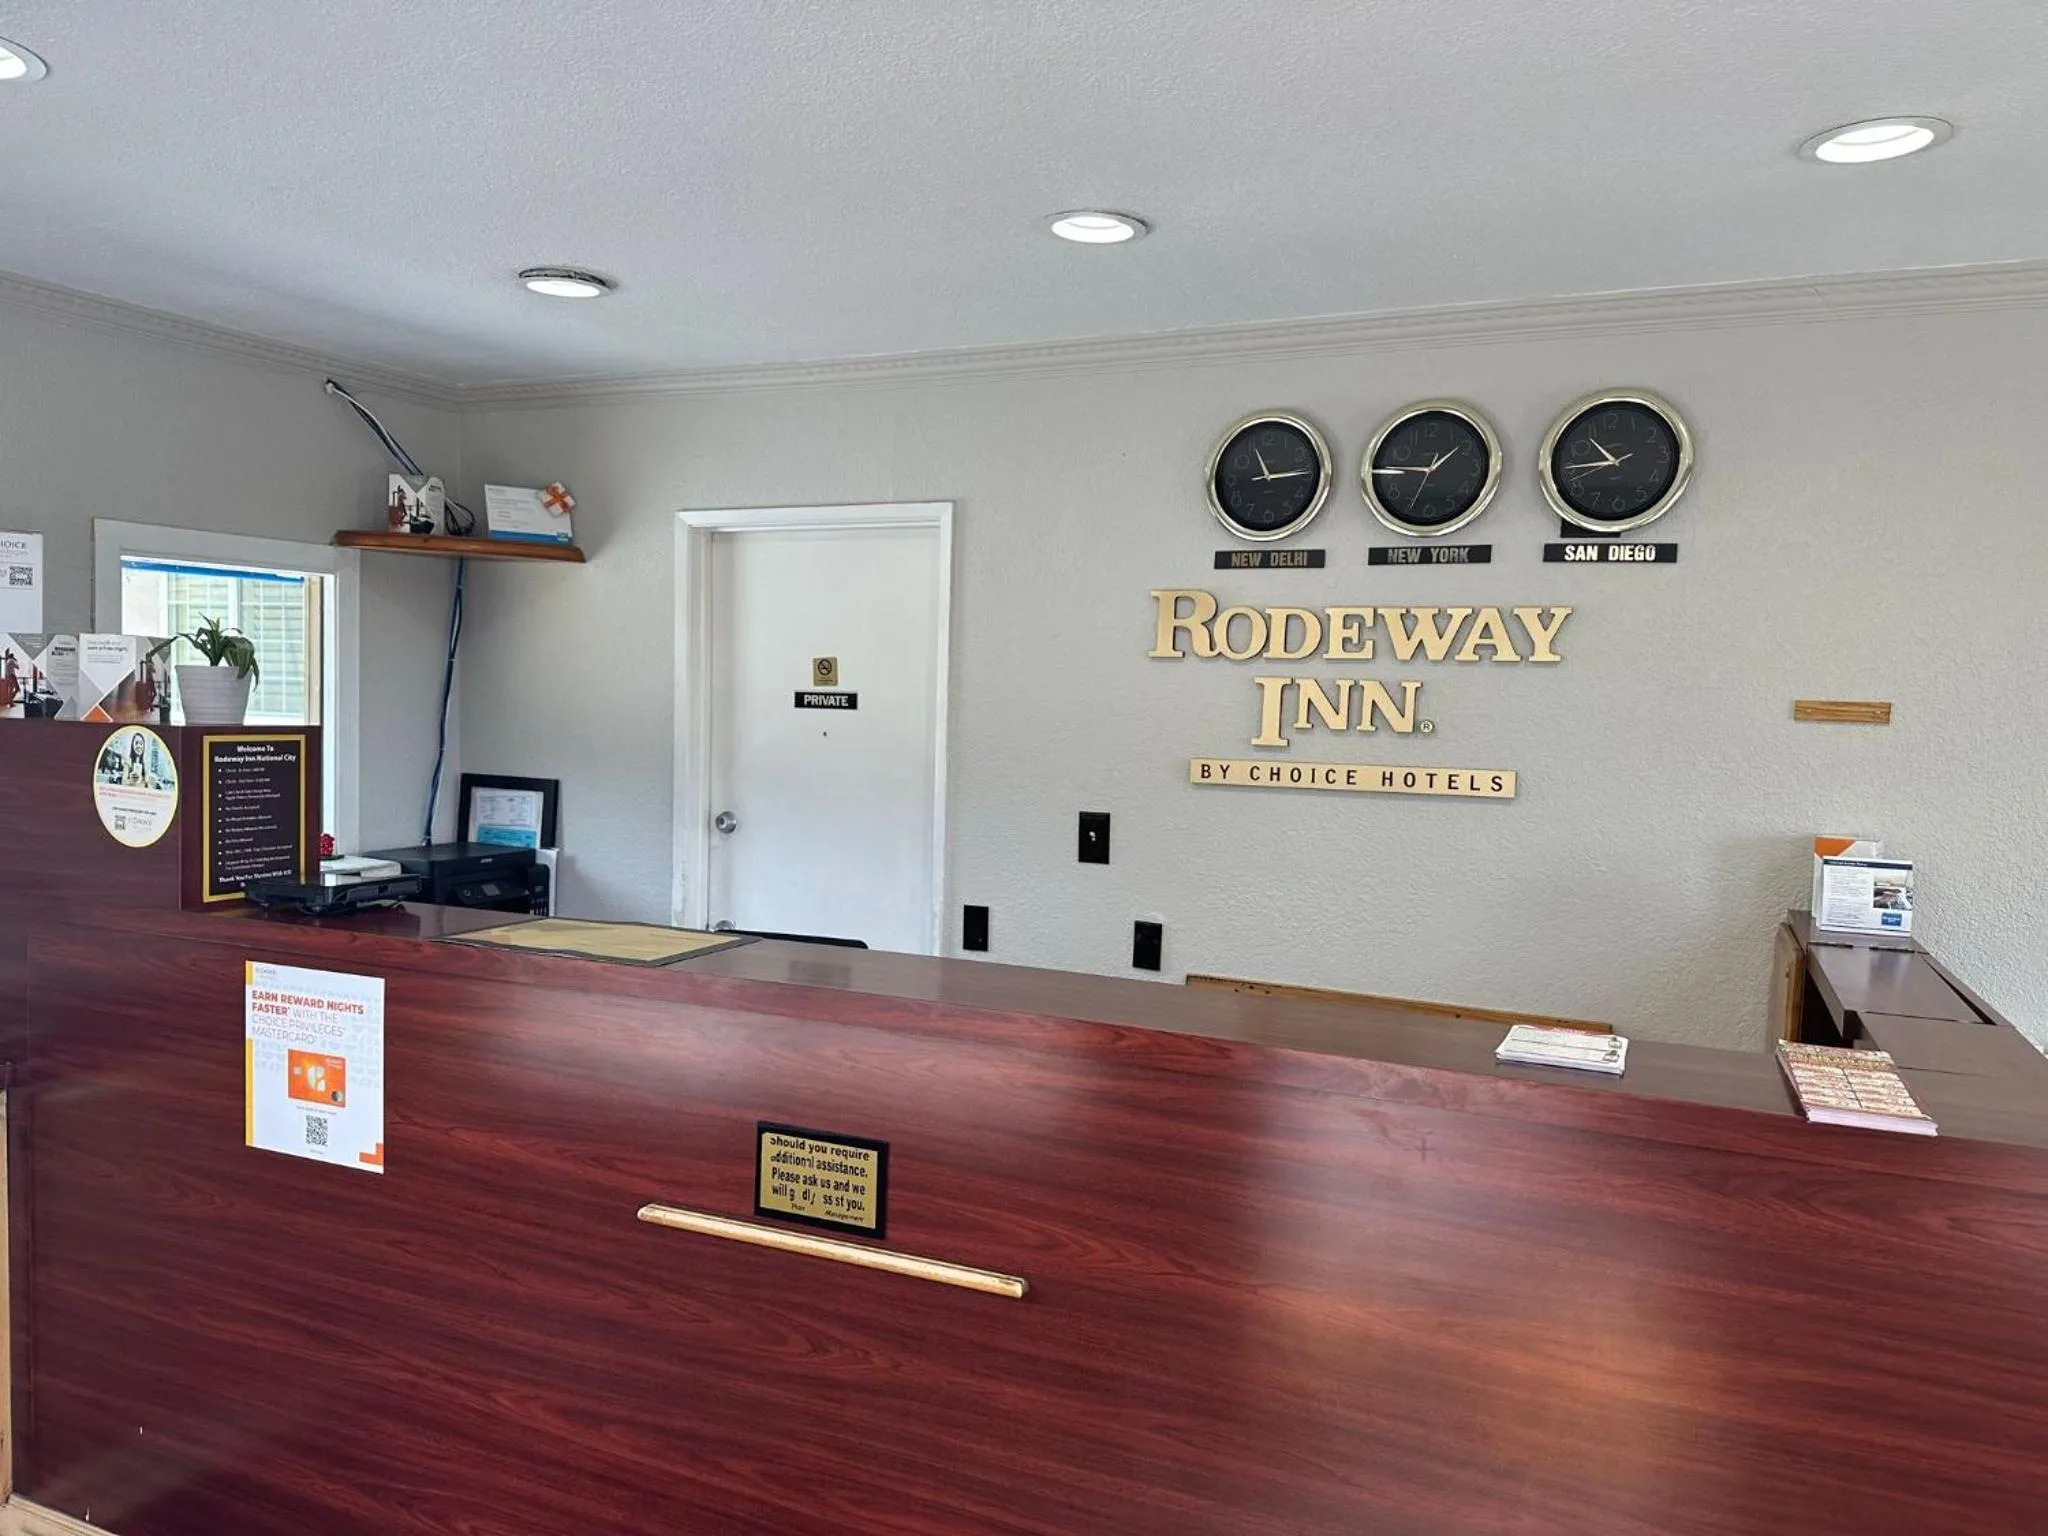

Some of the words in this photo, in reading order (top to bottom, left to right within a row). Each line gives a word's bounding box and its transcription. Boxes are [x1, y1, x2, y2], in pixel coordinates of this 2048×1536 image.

[1231, 552, 1262, 567] NEW
[1270, 552, 1308, 567] DELHI
[1387, 548, 1421, 563] NEW
[1430, 547, 1469, 563] YORK
[1563, 545, 1598, 561] SAN
[1608, 544, 1656, 561] DIEGO
[1148, 589, 1573, 663] RODEWAY
[804, 694, 849, 707] PRIVATE
[237, 745, 265, 753] Welcome
[266, 744, 274, 752] To
[214, 755, 244, 764] Rodeway
[245, 755, 256, 763] Inn
[257, 754, 283, 762] National
[284, 753, 297, 761] City
[1200, 763, 1231, 780] BY
[1249, 765, 1357, 786] CHOICE
[1382, 771, 1504, 793] HOTELS
[252, 990, 278, 1002] EARN
[281, 994, 325, 1010] REWARD
[327, 1001, 365, 1015] NIGHTS
[252, 1013, 288, 1029] CHOICE
[292, 1008, 319, 1021] WITH
[320, 1011, 339, 1024] THE
[808, 1143, 828, 1154] you
[830, 1147, 870, 1161] require
[816, 1159, 868, 1178] assistance.
[772, 1167, 801, 1184] Please
[802, 1174, 818, 1187] ask
[820, 1179, 831, 1188] us
[833, 1180, 850, 1192] and
[851, 1183, 865, 1195] we
[772, 1183, 787, 1197] will
[846, 1198, 865, 1212] you.
